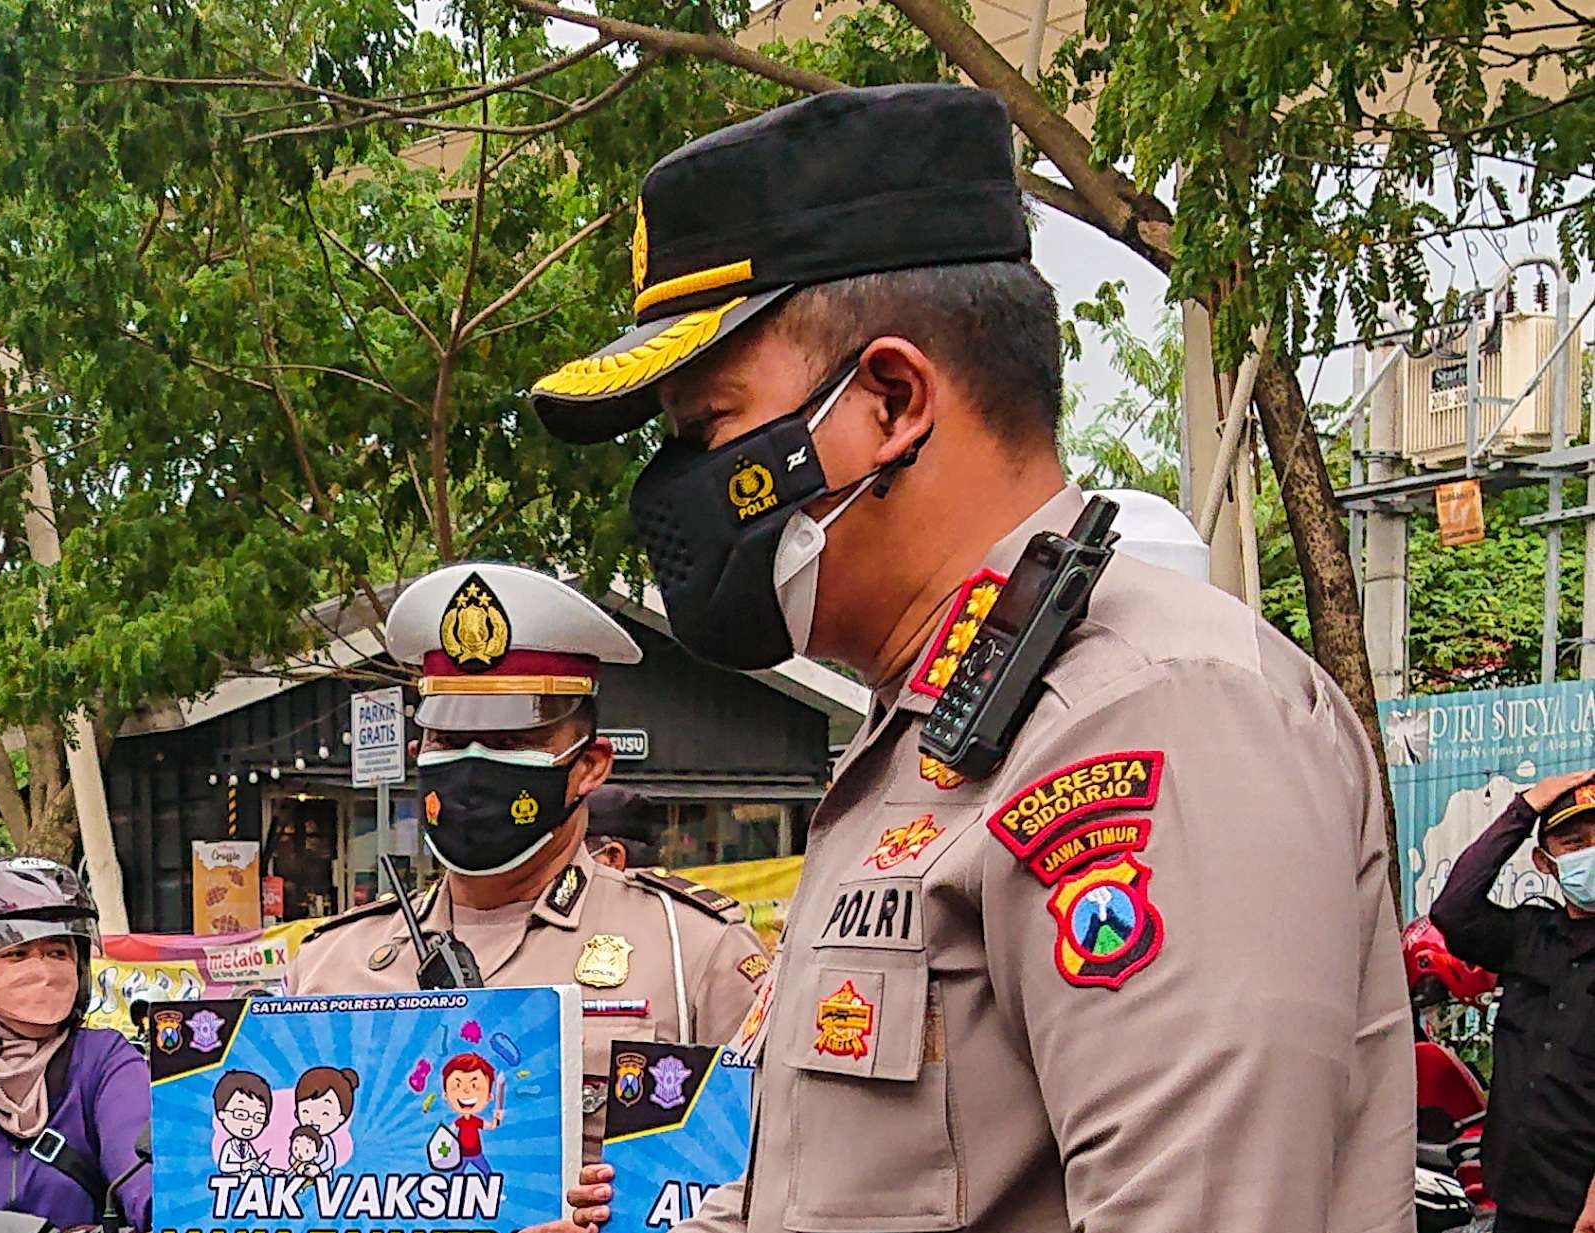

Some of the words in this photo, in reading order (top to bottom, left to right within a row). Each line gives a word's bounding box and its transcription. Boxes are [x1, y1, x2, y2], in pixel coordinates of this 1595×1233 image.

[738, 494, 778, 521] POLRI
[359, 703, 396, 722] PARKIR
[359, 724, 396, 744] GRATIS
[1428, 703, 1485, 745] PURI
[1491, 696, 1565, 741] SURYA
[1002, 760, 1147, 831] POLRESTA
[1022, 780, 1132, 836] SIDOARJO
[1044, 838, 1085, 872] JAWA
[1086, 826, 1138, 849] TIMUR
[821, 888, 913, 940] POLRI
[251, 1000, 328, 1014] SATLANTAS
[330, 998, 396, 1011] POLRESTA
[398, 996, 467, 1009] SIDOARJO
[209, 1176, 304, 1218] TAK
[313, 1174, 504, 1218] VAKSIN
